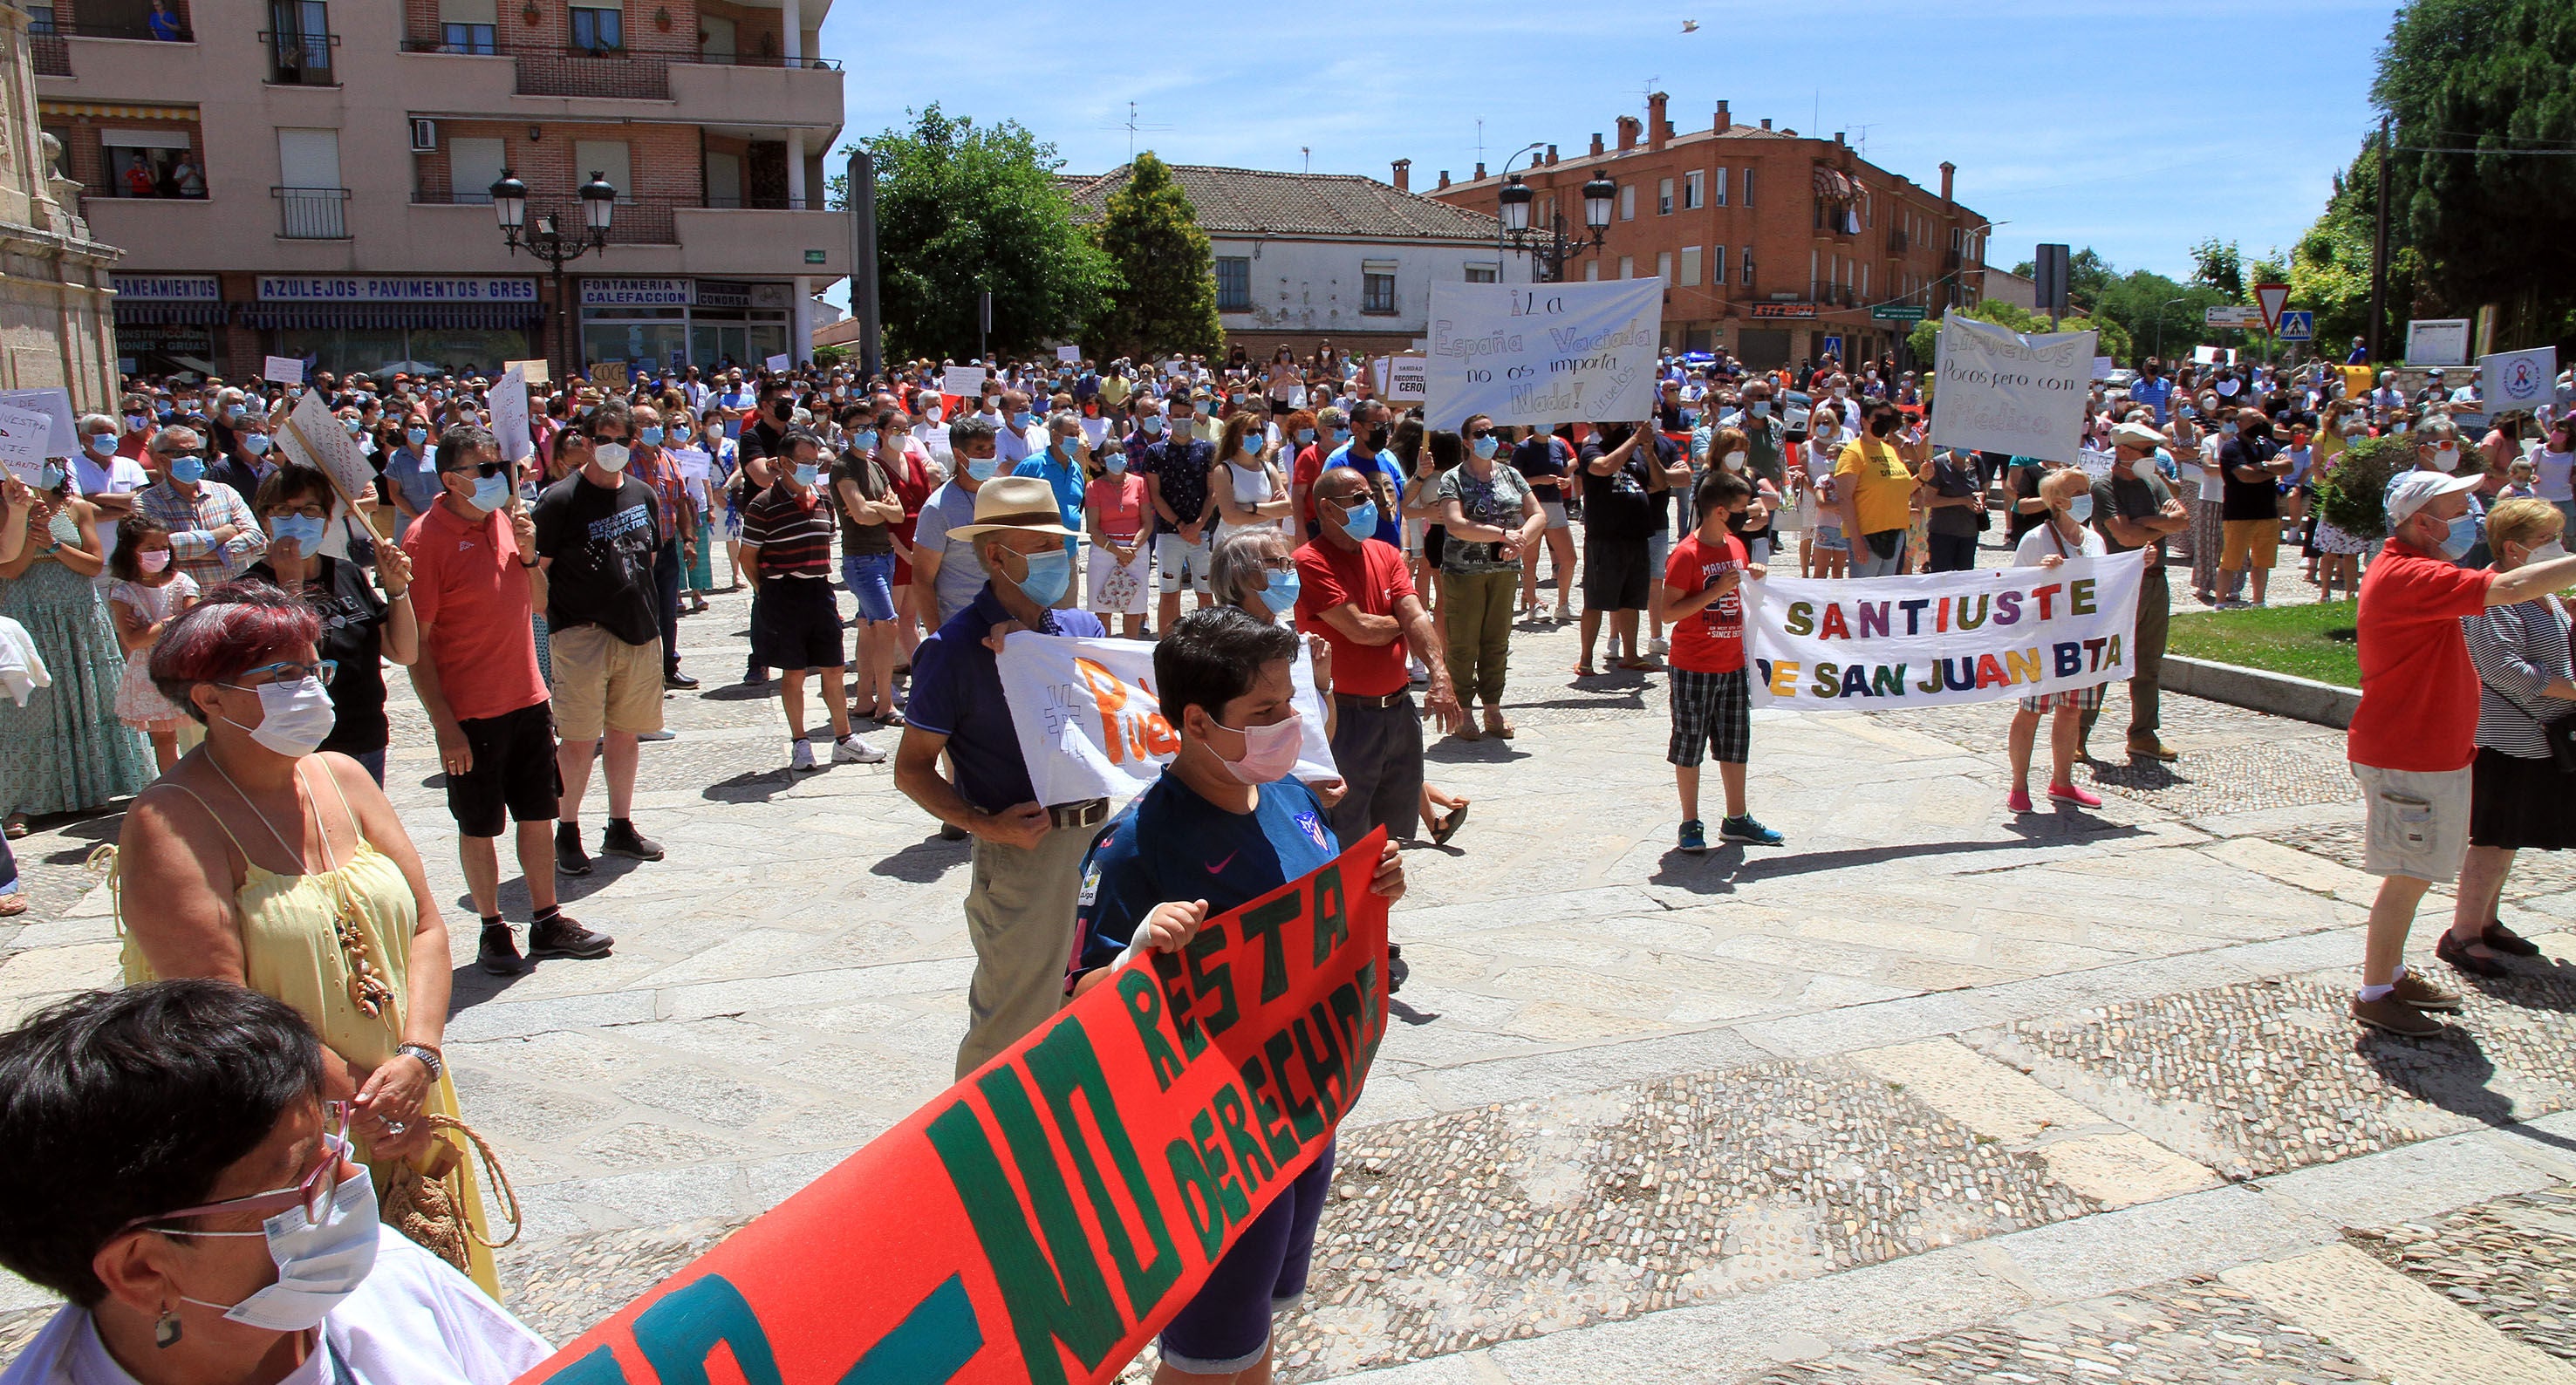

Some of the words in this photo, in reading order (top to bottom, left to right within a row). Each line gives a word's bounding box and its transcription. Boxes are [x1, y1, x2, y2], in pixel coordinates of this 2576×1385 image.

[114, 278, 216, 297] SANEAMIENTOS
[263, 279, 357, 298] AZULEJOS
[369, 280, 479, 298] PAVIMENTOS
[489, 281, 533, 298] GRES
[583, 279, 673, 291] FONTANERIA
[679, 280, 688, 291] Y
[587, 291, 687, 304] CALEFACCION
[167, 341, 208, 350] GRUAS
[1434, 319, 1524, 365] España
[1549, 318, 1651, 354] Vaciada
[1393, 374, 1425, 383] RECORTES
[1466, 368, 1493, 384] no
[1507, 364, 1535, 380] os
[1549, 352, 1617, 376] importa
[1943, 358, 1987, 385] Pocos
[1992, 372, 2028, 389] pero
[2038, 379, 2074, 392] con
[1510, 381, 1585, 415] Nada!
[1583, 365, 1636, 420] Ciruelos
[313, 596, 359, 617] OVE
[1784, 578, 2097, 641] SANTIUSTE
[1810, 662, 1907, 699] SAN
[1917, 647, 2042, 694] JUAN
[2053, 634, 2122, 679] BTA
[1116, 864, 1349, 1094] RESTA
[1165, 955, 1381, 1266] DERECHOS
[925, 1013, 1185, 1385] NO
